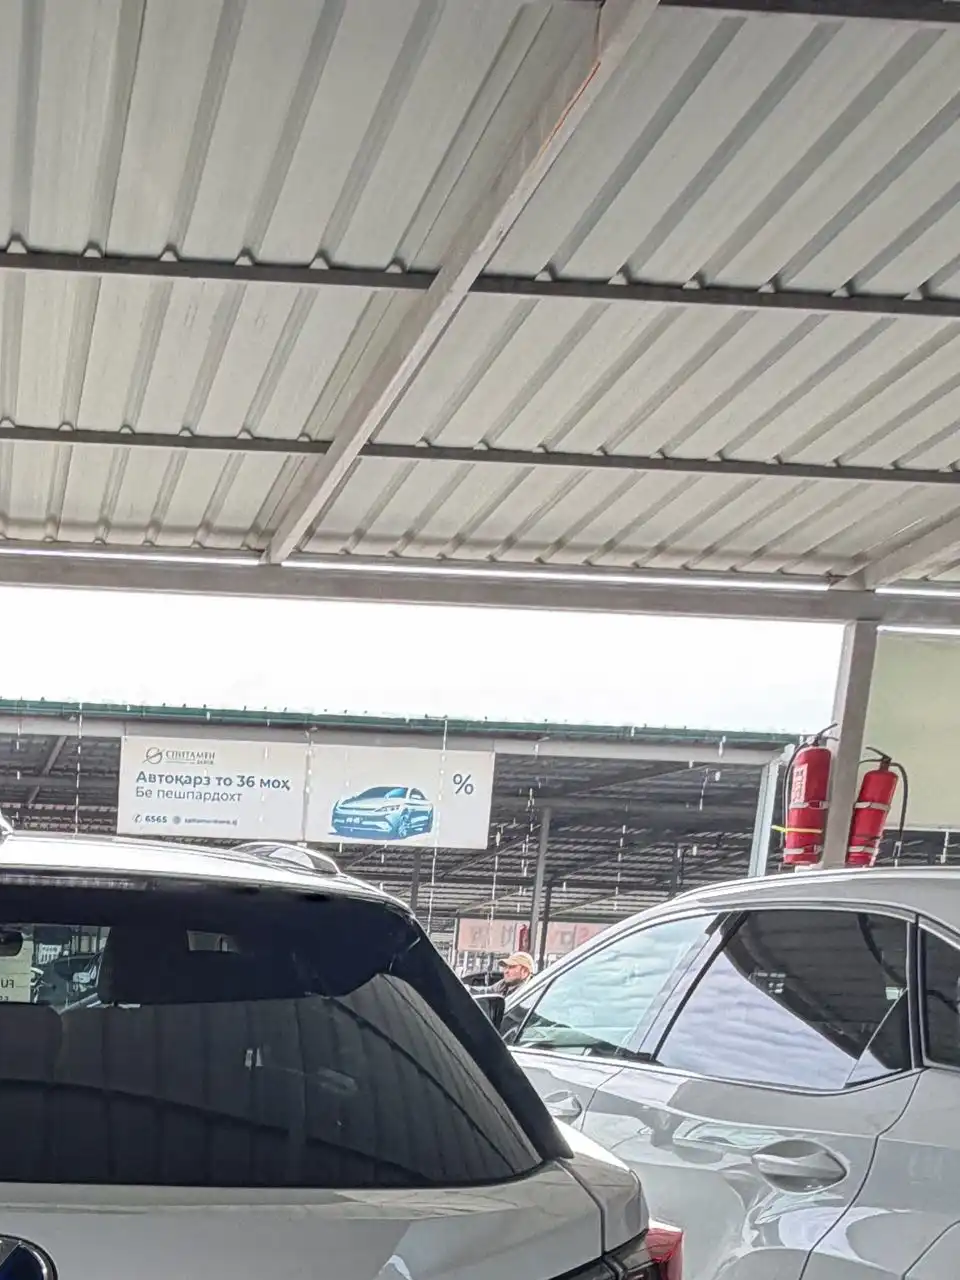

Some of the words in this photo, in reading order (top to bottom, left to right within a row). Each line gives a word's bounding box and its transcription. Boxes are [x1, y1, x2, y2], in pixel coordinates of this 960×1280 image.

[136, 771, 211, 786] Автоқарз
[215, 778, 233, 787] то
[236, 775, 255, 788] 36
[452, 773, 474, 795] %
[135, 786, 153, 798] Бе
[156, 791, 243, 803] пешпардохт
[145, 815, 168, 823] 6565
